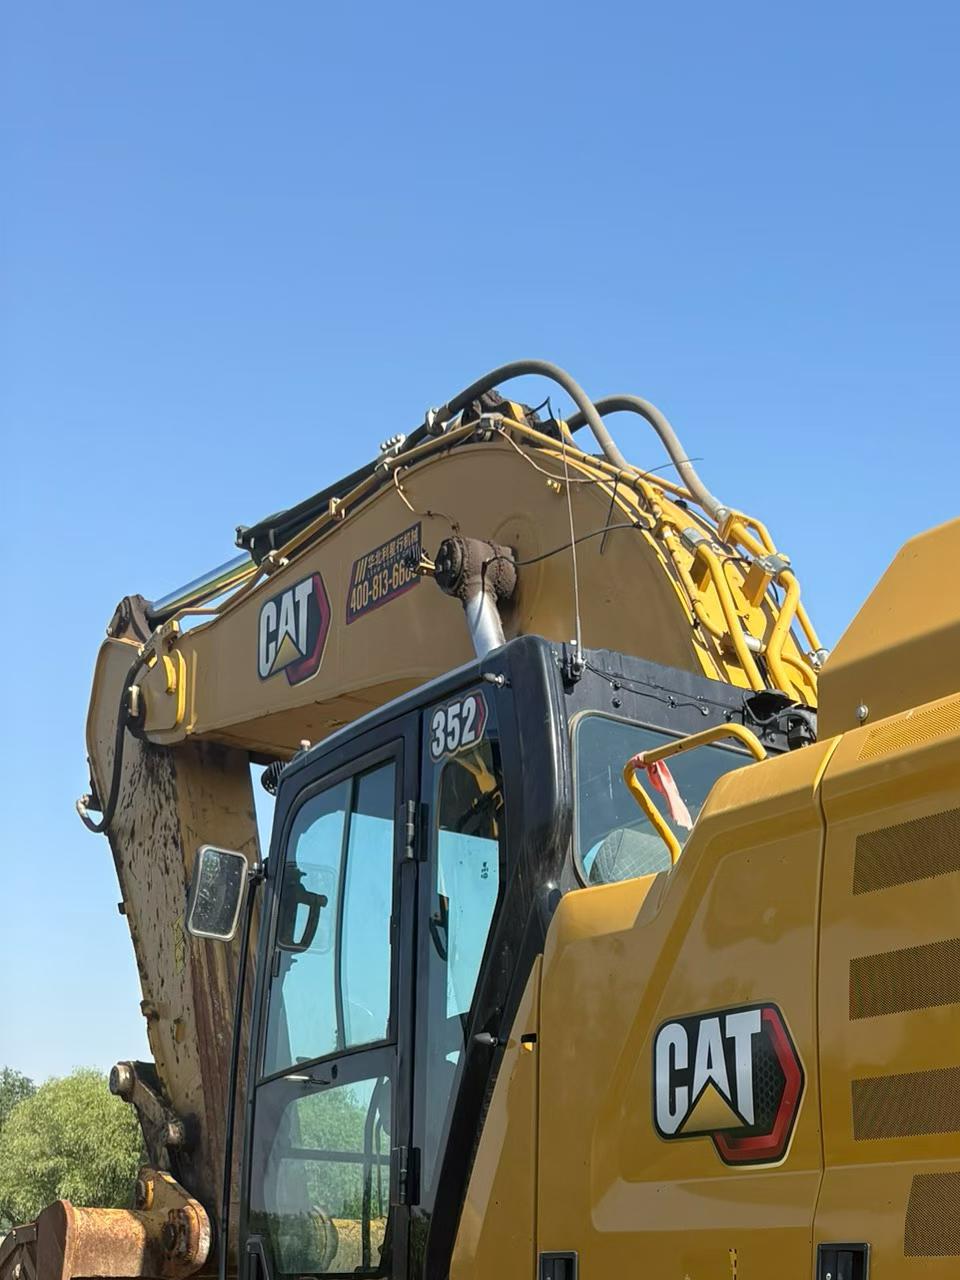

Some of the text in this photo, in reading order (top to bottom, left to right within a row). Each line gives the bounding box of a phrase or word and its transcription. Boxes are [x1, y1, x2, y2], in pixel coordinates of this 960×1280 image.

[351, 559, 418, 613] 400-813-66
[259, 577, 313, 678] CAT
[432, 696, 477, 757] 352
[655, 1008, 762, 1135] CAT
